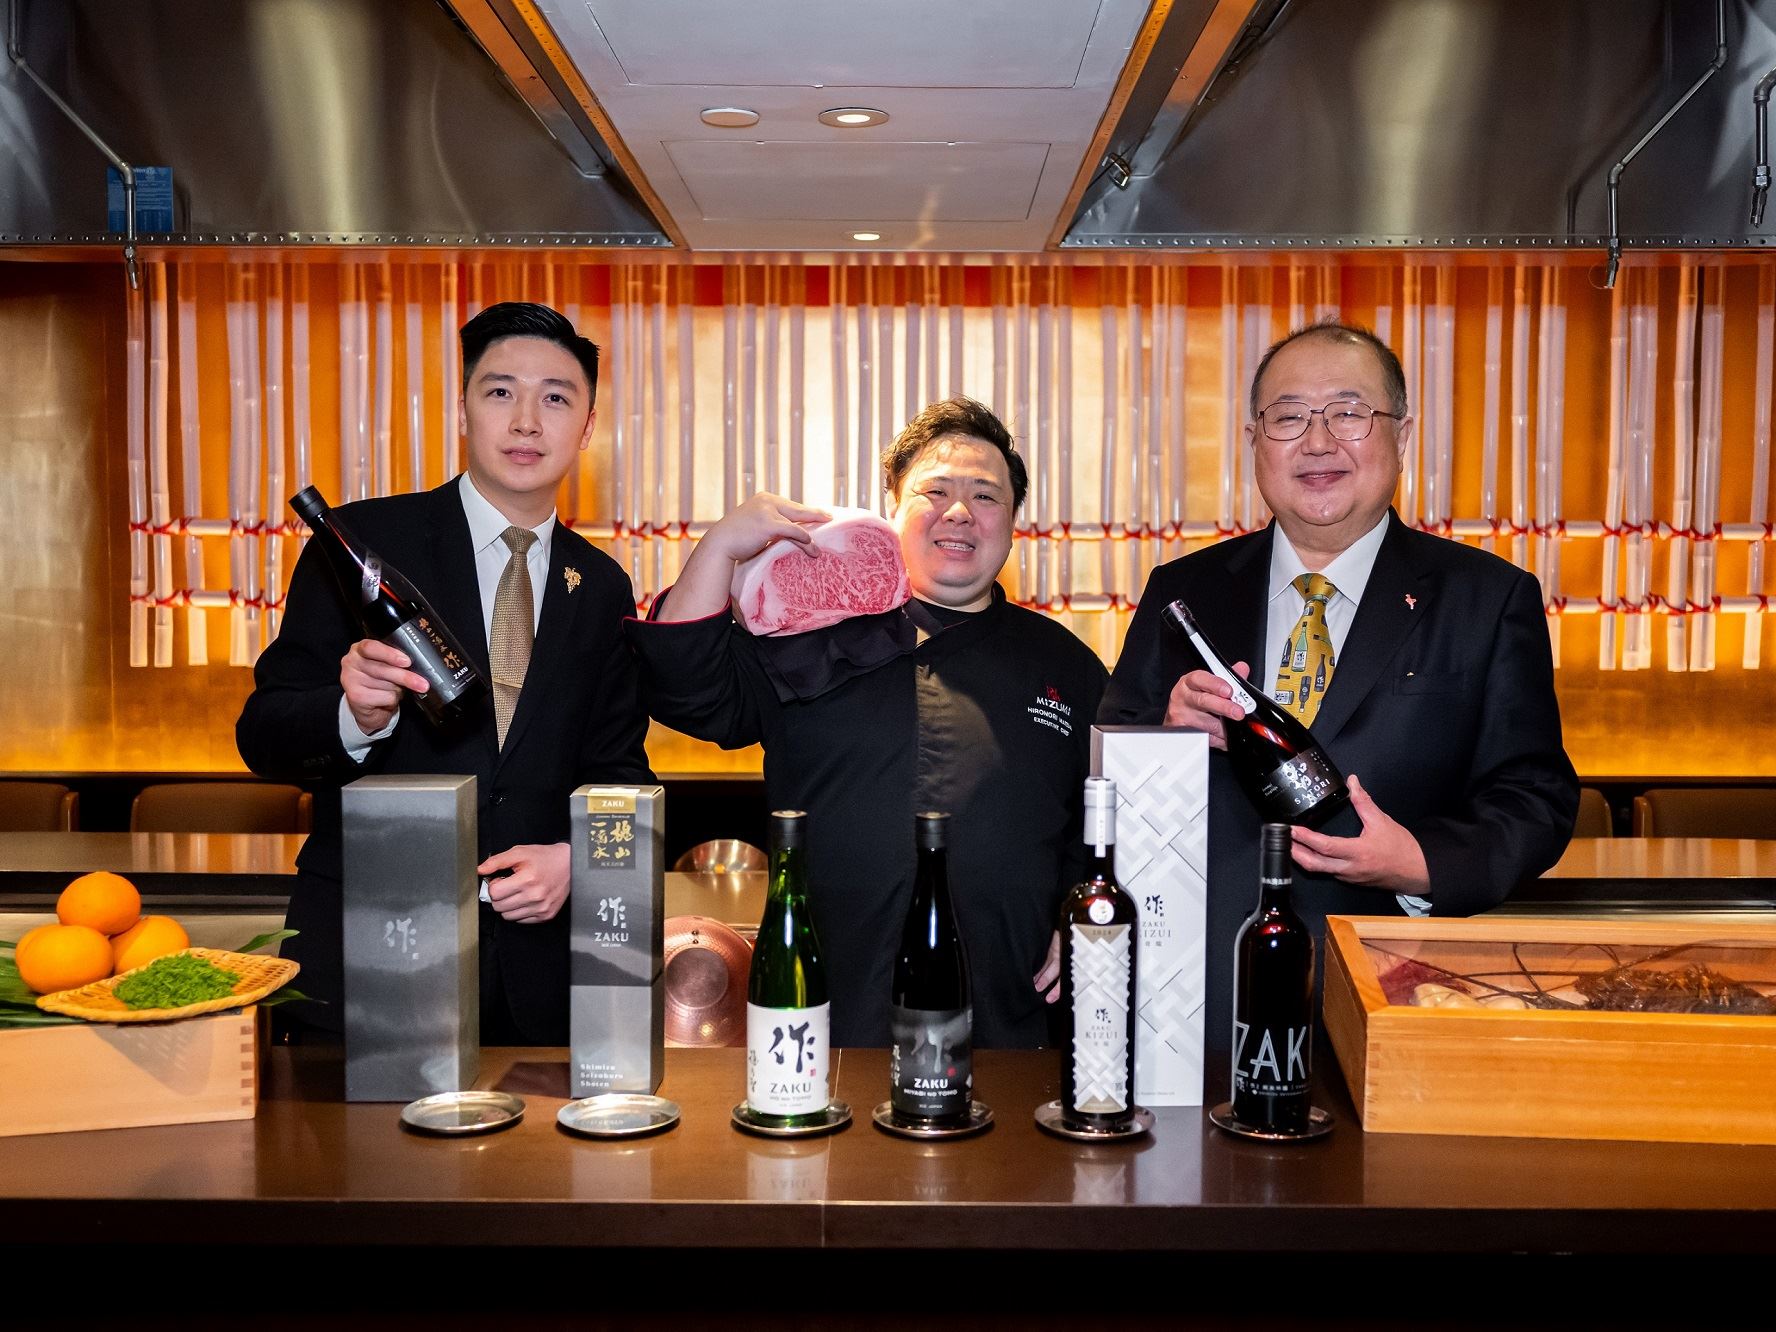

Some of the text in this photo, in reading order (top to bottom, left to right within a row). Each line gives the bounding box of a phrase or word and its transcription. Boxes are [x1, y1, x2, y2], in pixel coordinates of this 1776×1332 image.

[453, 666, 469, 680] ZAKU
[1027, 706, 1058, 721] HIRONORI
[1294, 778, 1331, 805] SATORI
[601, 799, 625, 808] ZAKU
[596, 896, 627, 927] 作
[1144, 894, 1163, 915] 作
[594, 932, 629, 942] ZAKU
[1085, 1031, 1118, 1040] KIZUI
[768, 1021, 816, 1073] 作
[1233, 1019, 1312, 1082] ZAK
[770, 1082, 812, 1095] ZAKU
[913, 1077, 949, 1090] ZAKU
